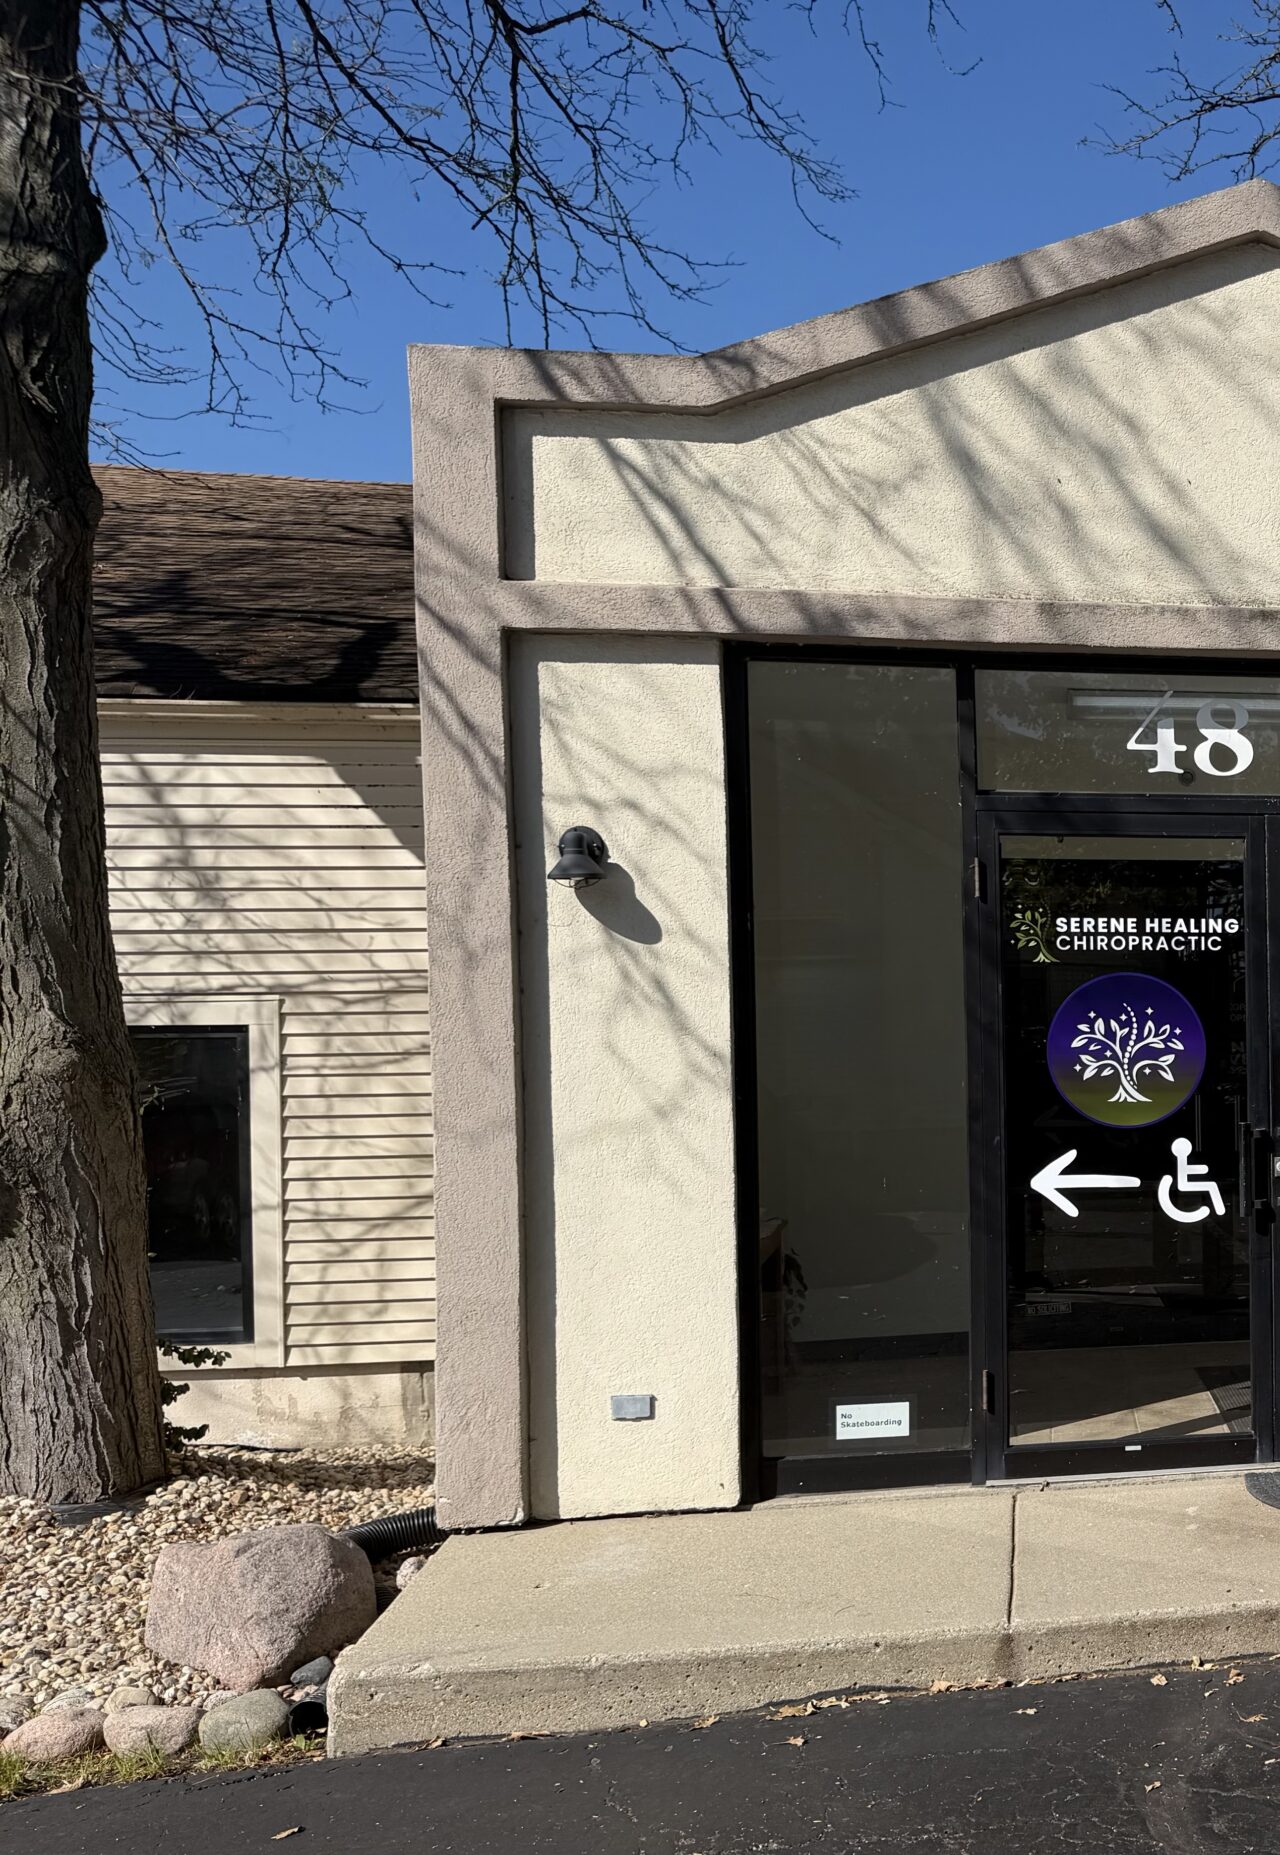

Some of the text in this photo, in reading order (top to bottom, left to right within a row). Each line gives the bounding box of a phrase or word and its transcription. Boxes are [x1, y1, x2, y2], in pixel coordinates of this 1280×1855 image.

[1126, 690, 1254, 777] 48
[1055, 918, 1239, 934] SERENE HEALING
[1055, 935, 1223, 951] CHIROPRACTIC
[840, 1419, 902, 1428] Skateboarding
